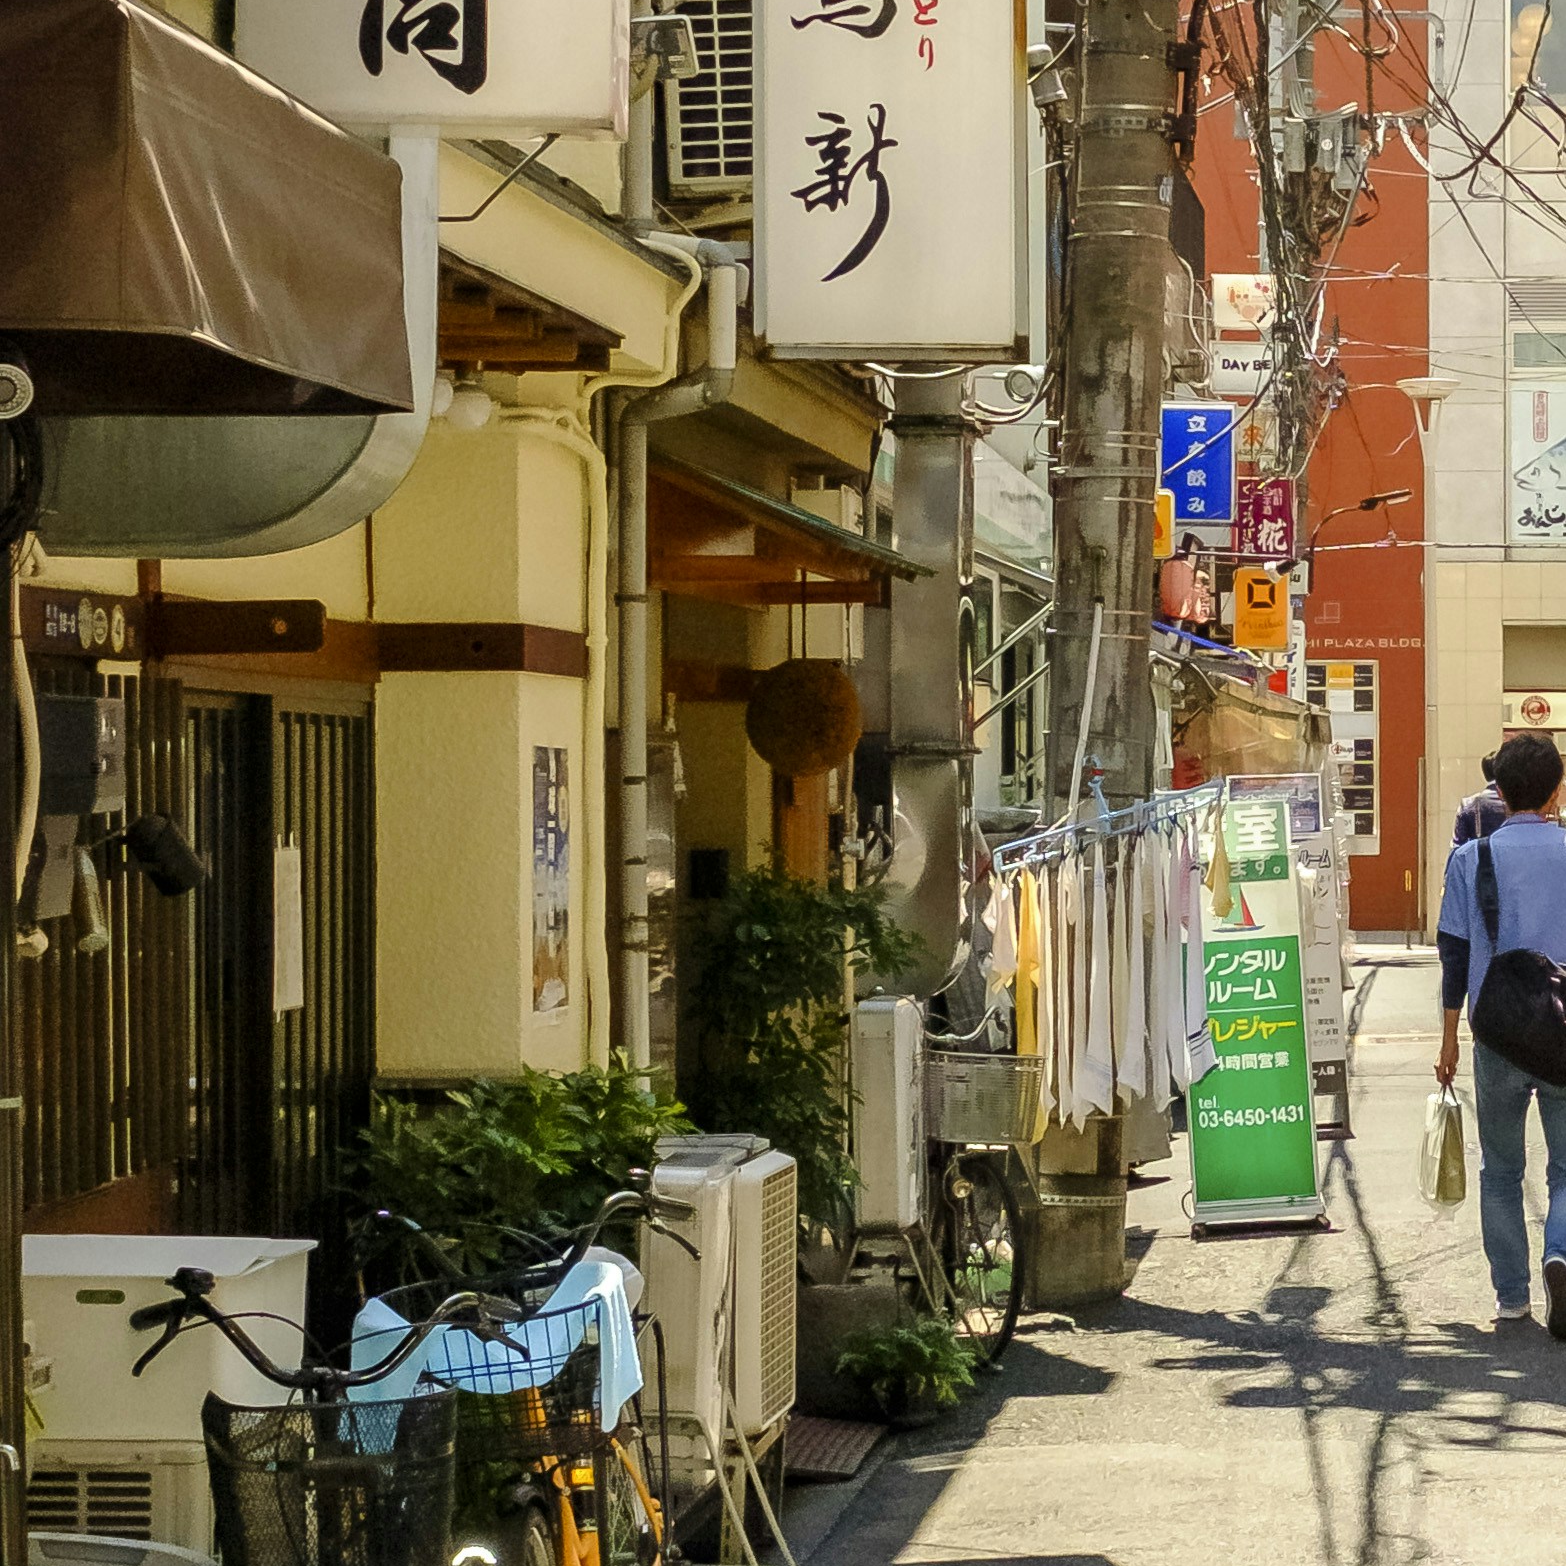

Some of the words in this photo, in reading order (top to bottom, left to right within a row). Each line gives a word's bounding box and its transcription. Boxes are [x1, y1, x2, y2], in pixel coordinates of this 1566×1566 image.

[1324, 638, 1375, 648] PLAZA
[1379, 638, 1425, 648] BLDG.
[1208, 977, 1278, 1004] ルーム
[1208, 1014, 1297, 1042] レジャー
[1216, 1051, 1290, 1072] 4時間営業
[1198, 1095, 1220, 1109] tel.
[1199, 1105, 1305, 1128] 03-6450-1431
